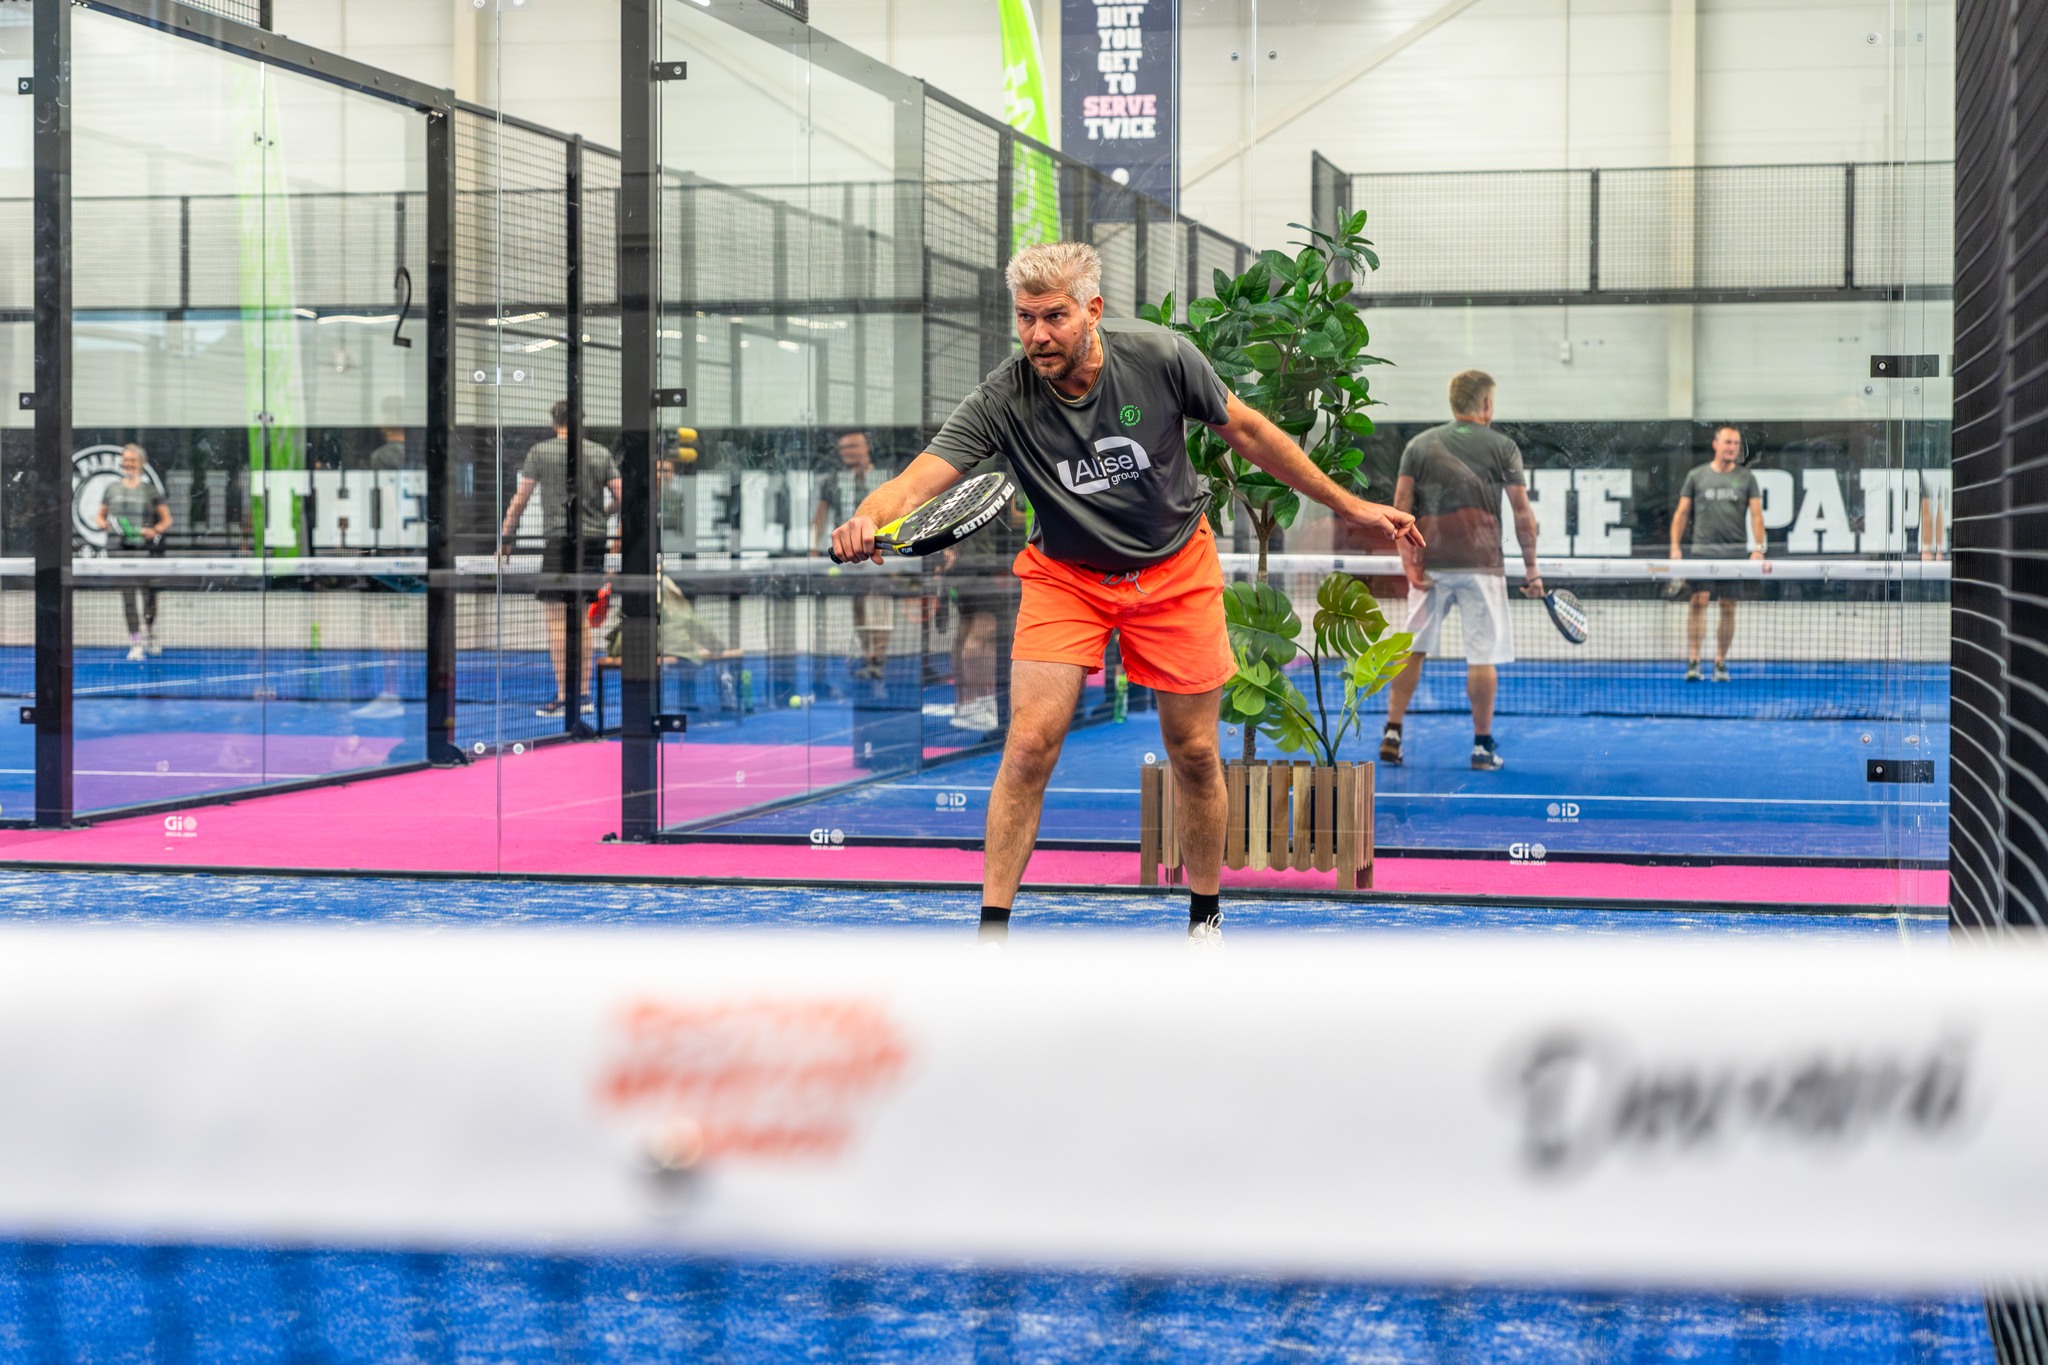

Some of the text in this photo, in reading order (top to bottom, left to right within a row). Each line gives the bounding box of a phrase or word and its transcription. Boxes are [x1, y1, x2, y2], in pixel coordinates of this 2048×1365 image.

[1097, 6, 1144, 27] BUT
[1098, 28, 1142, 49] YOU
[1098, 50, 1142, 72] GET
[1104, 73, 1136, 94] TO
[1083, 94, 1157, 117] SERVE
[1084, 117, 1156, 139] TWICE
[1111, 471, 1140, 485] group
[250, 470, 428, 547] THE
